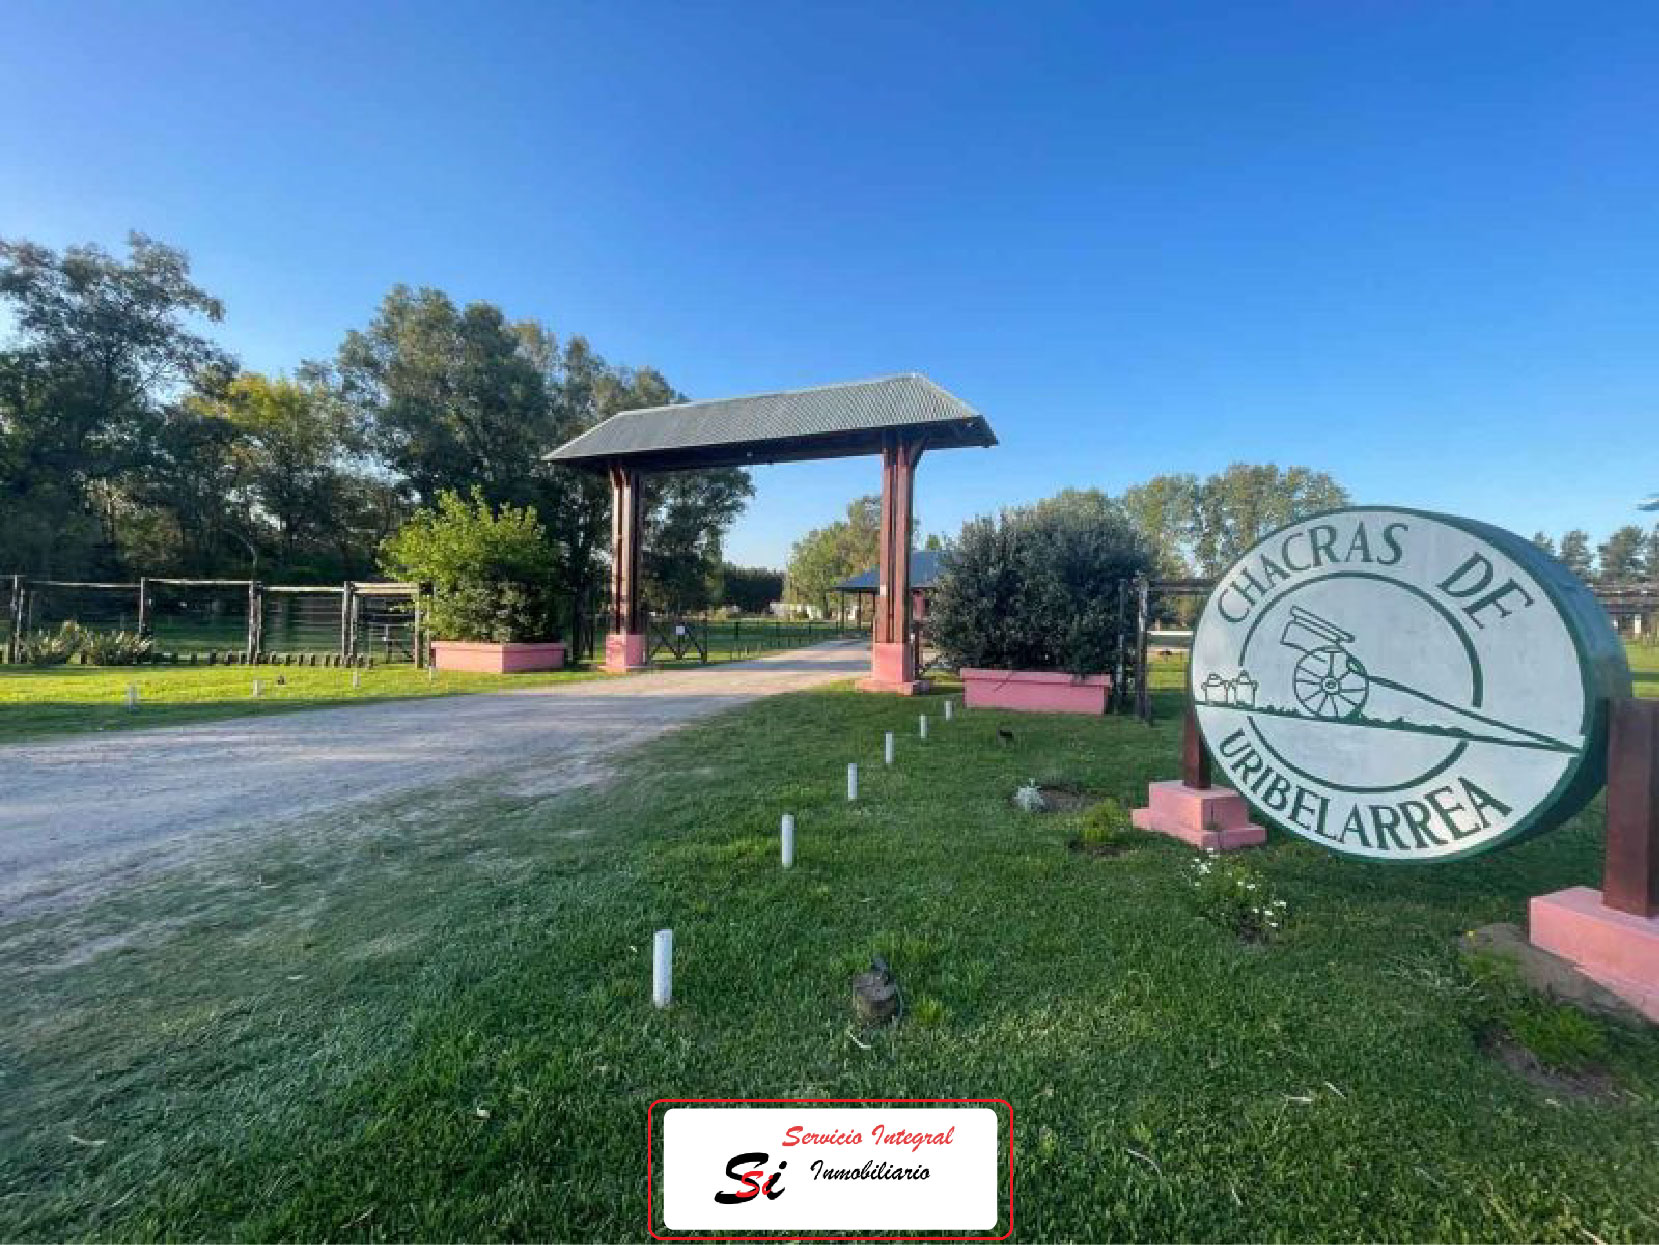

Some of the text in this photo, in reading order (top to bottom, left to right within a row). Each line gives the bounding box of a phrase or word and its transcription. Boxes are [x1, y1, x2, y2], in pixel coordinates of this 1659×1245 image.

[1218, 521, 1534, 630] CHACRAS DE
[1219, 729, 1512, 850] URIBELARREA
